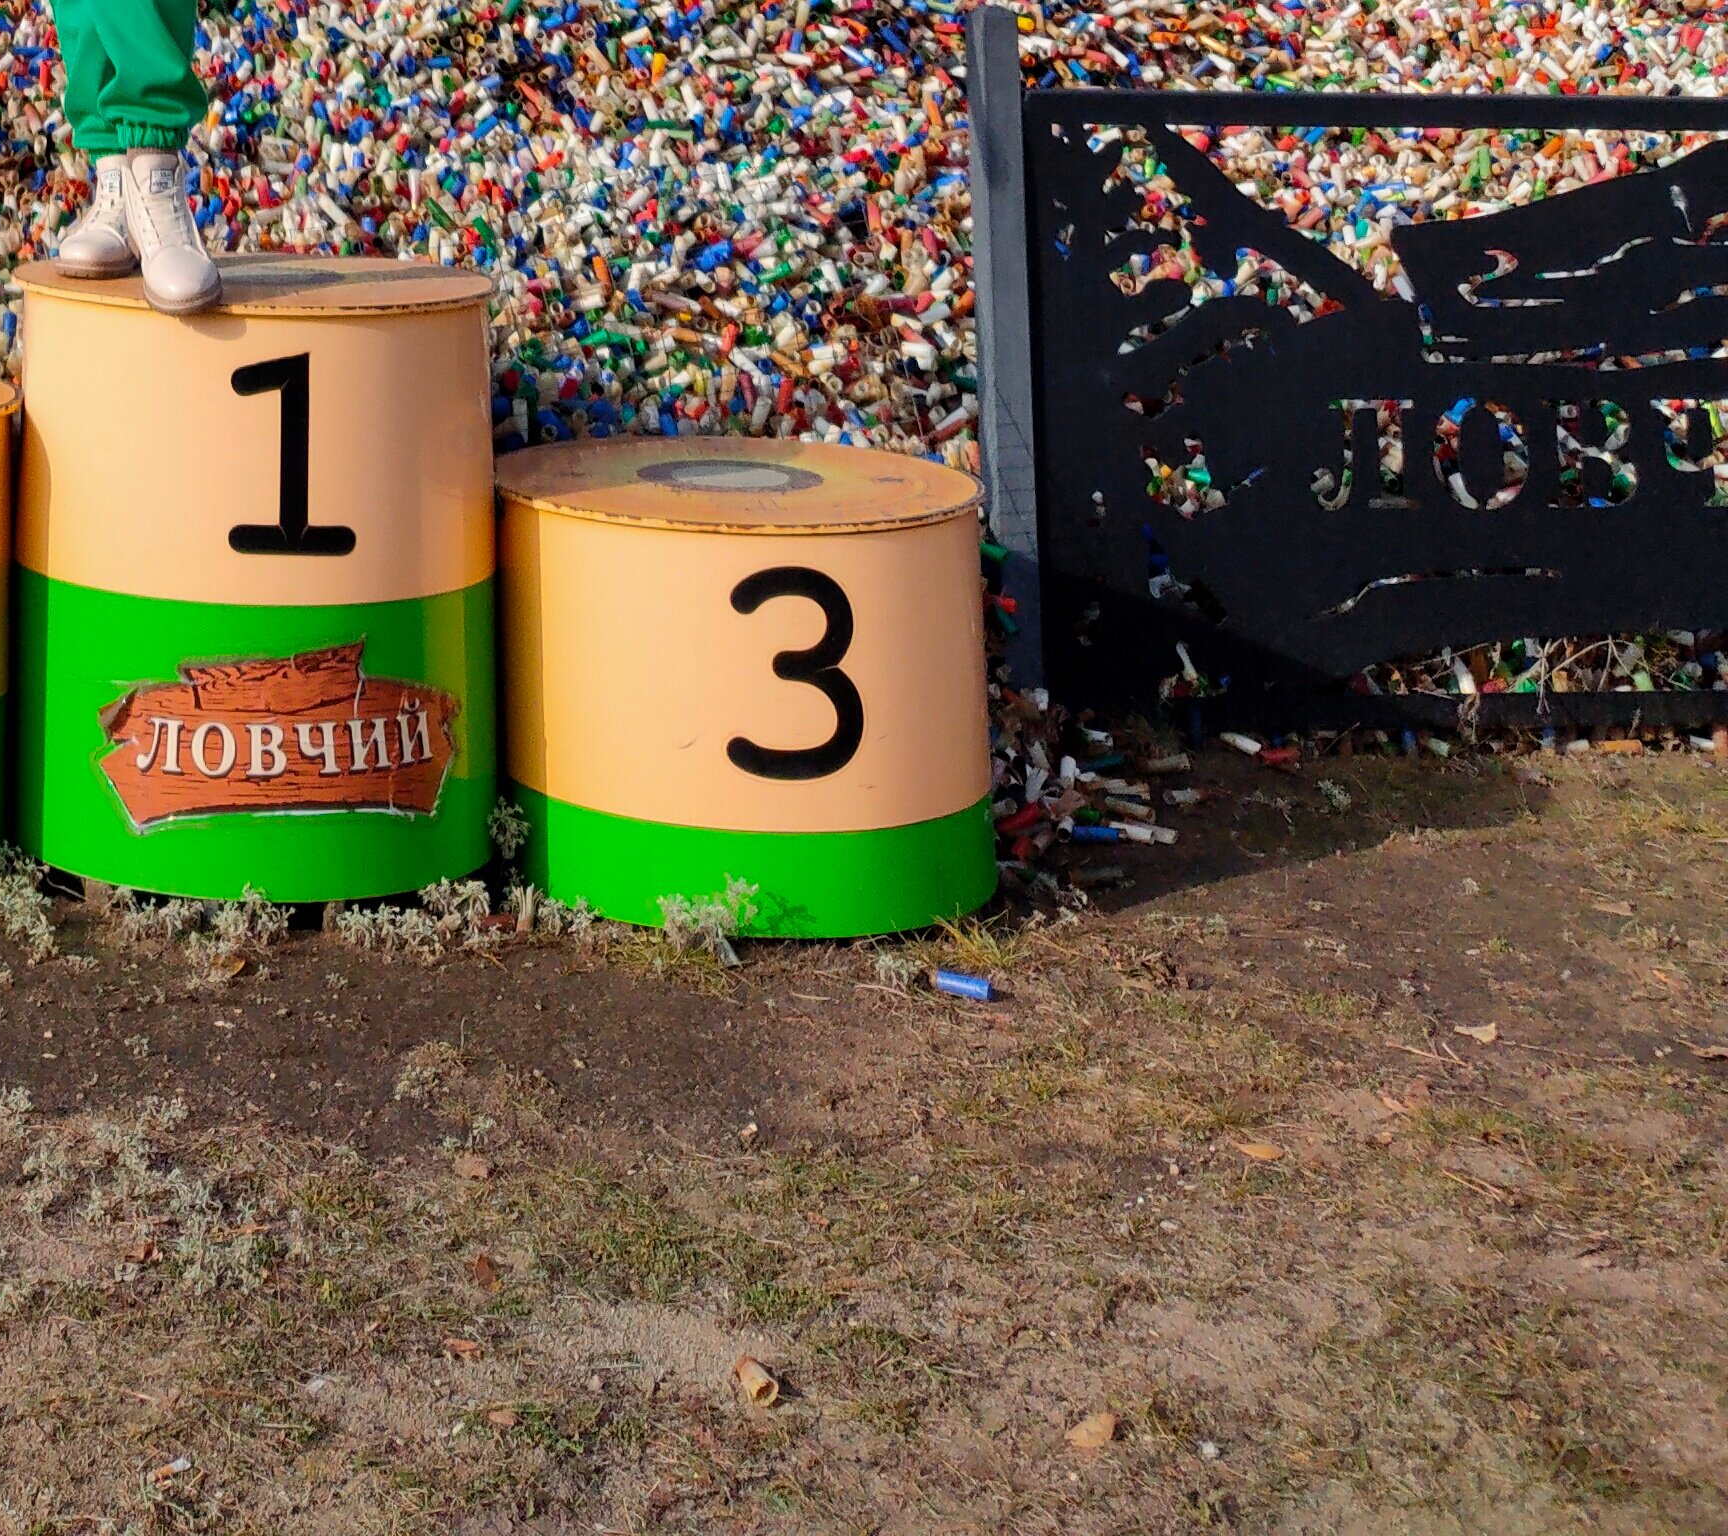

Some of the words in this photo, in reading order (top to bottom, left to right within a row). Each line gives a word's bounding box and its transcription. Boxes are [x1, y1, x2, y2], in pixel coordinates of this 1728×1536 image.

[228, 352, 357, 556] 1
[135, 696, 434, 778] ЛОВЧИЙ
[726, 566, 864, 781] 3
